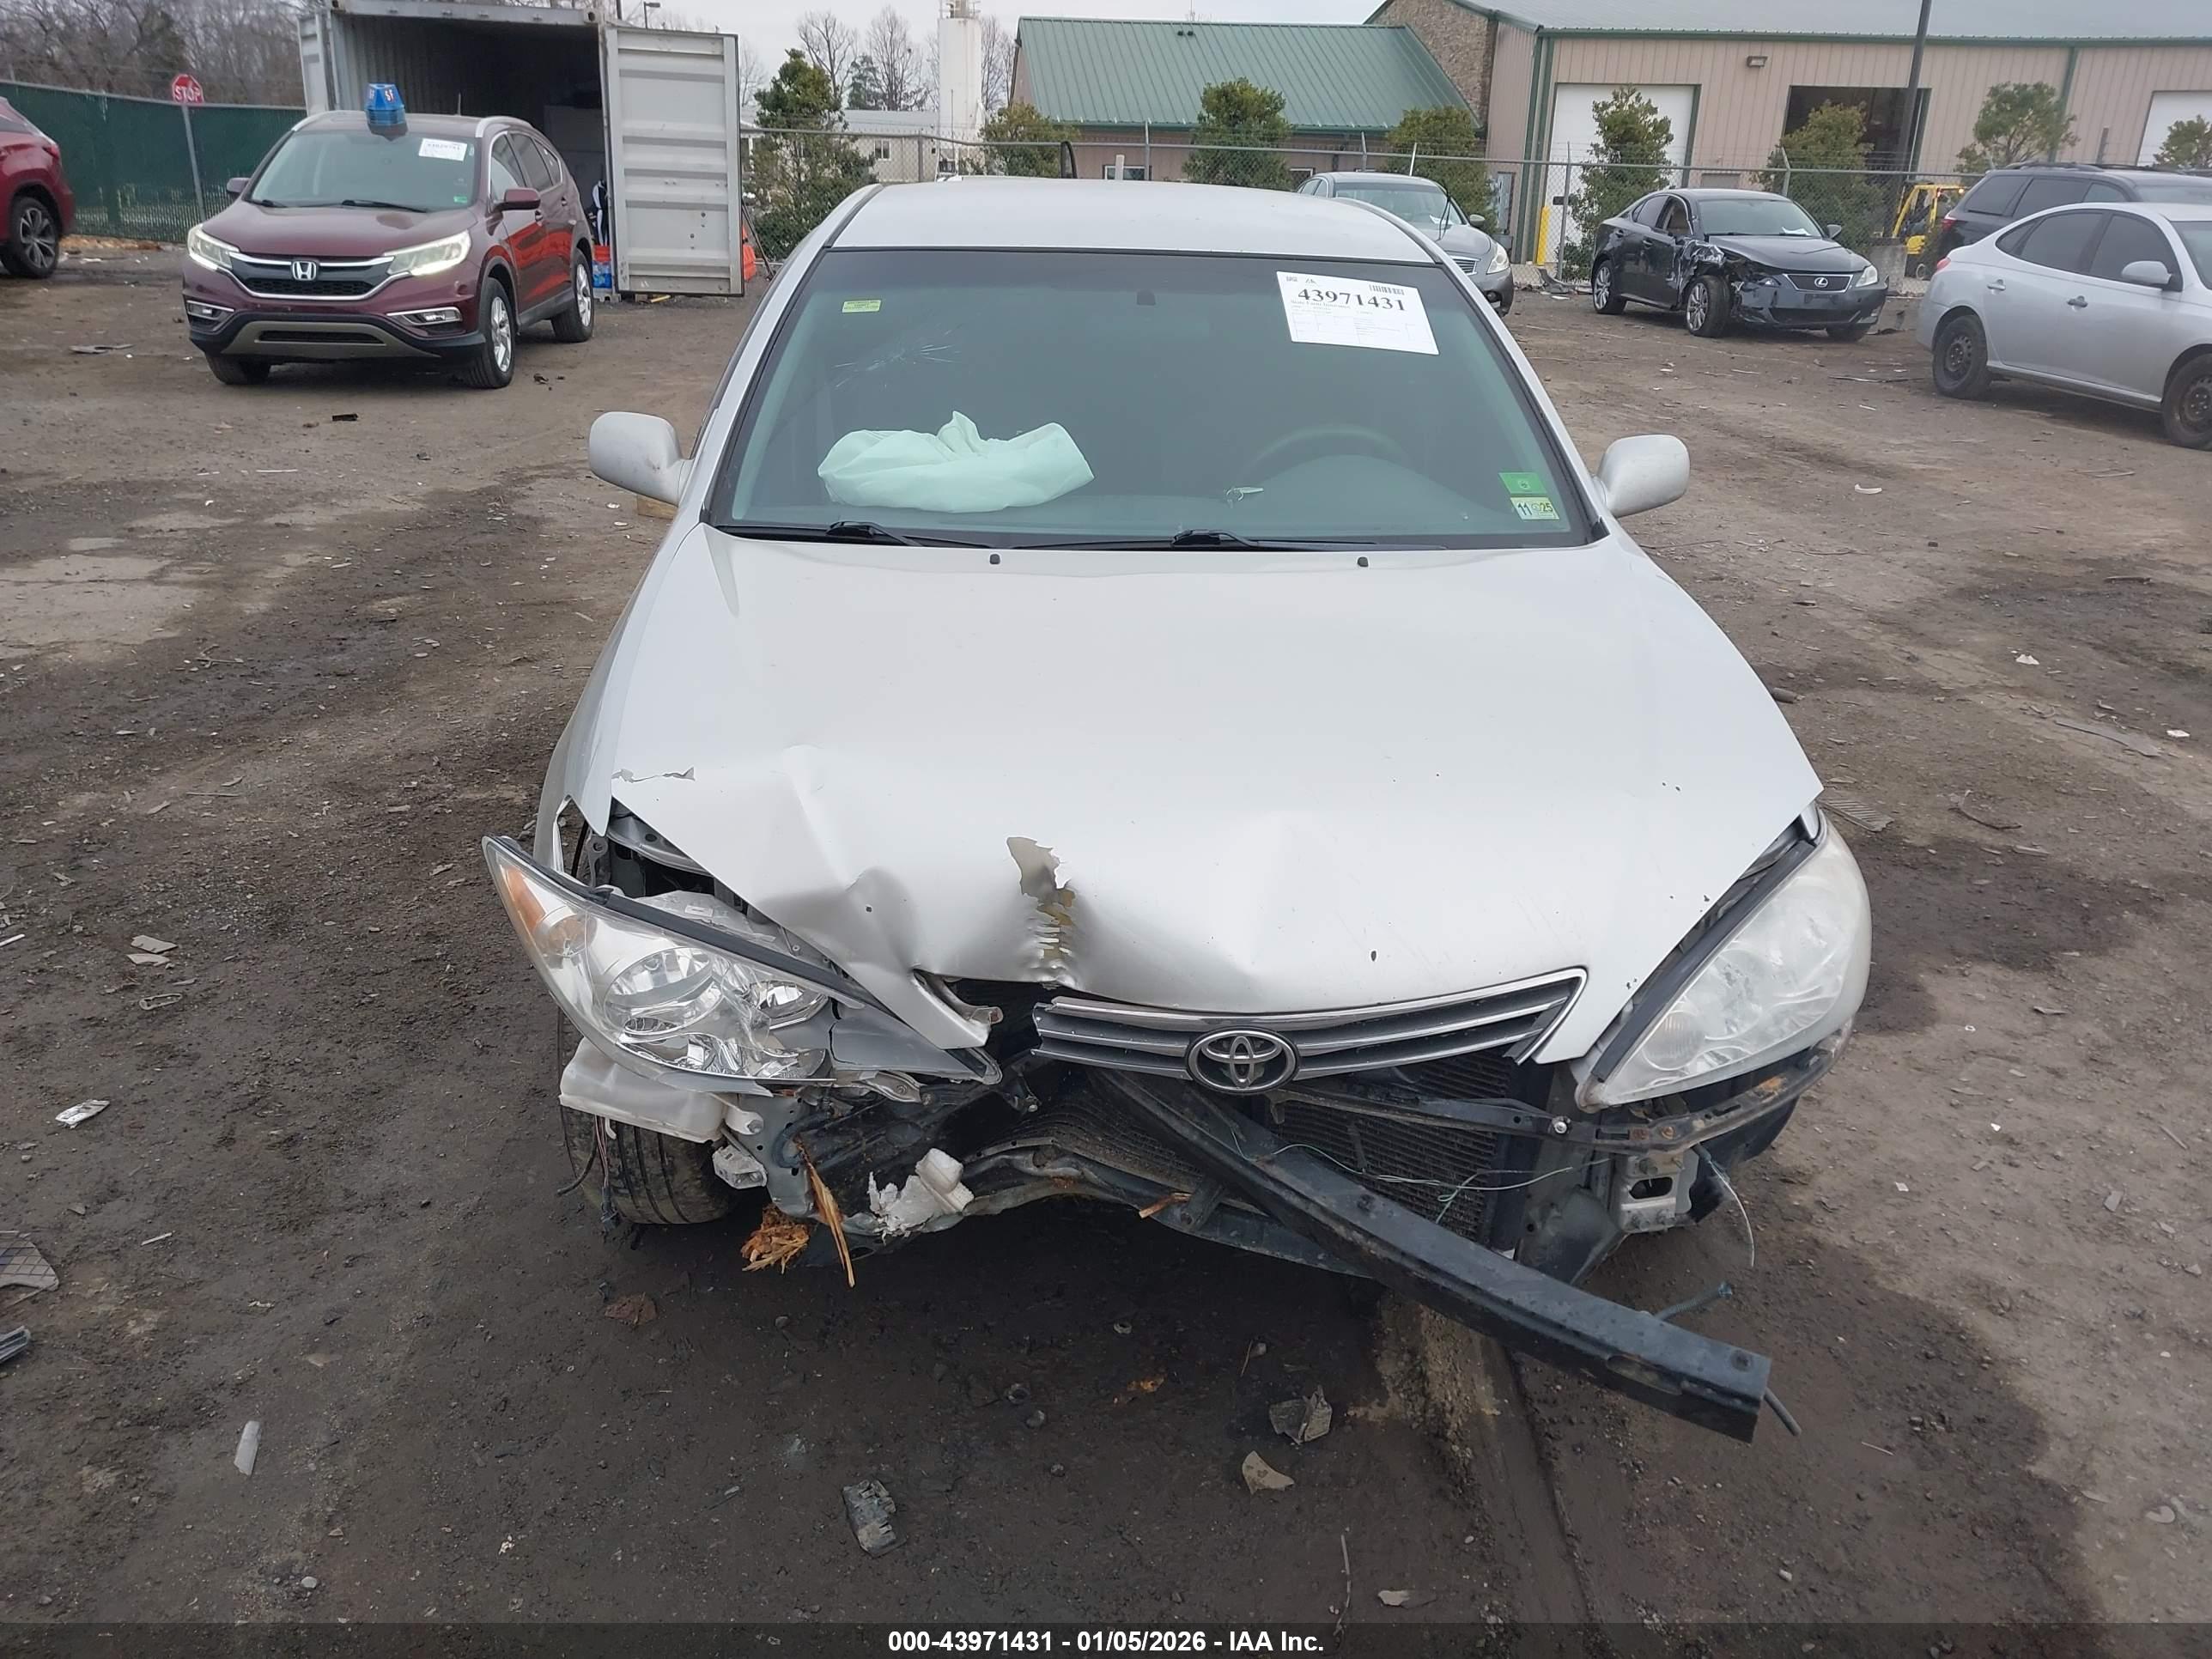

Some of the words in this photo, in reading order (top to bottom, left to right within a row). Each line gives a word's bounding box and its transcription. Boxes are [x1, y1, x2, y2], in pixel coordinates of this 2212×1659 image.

[175, 86, 201, 101] STOP
[1297, 289, 1405, 311] 43971431
[1517, 502, 1533, 516] 11
